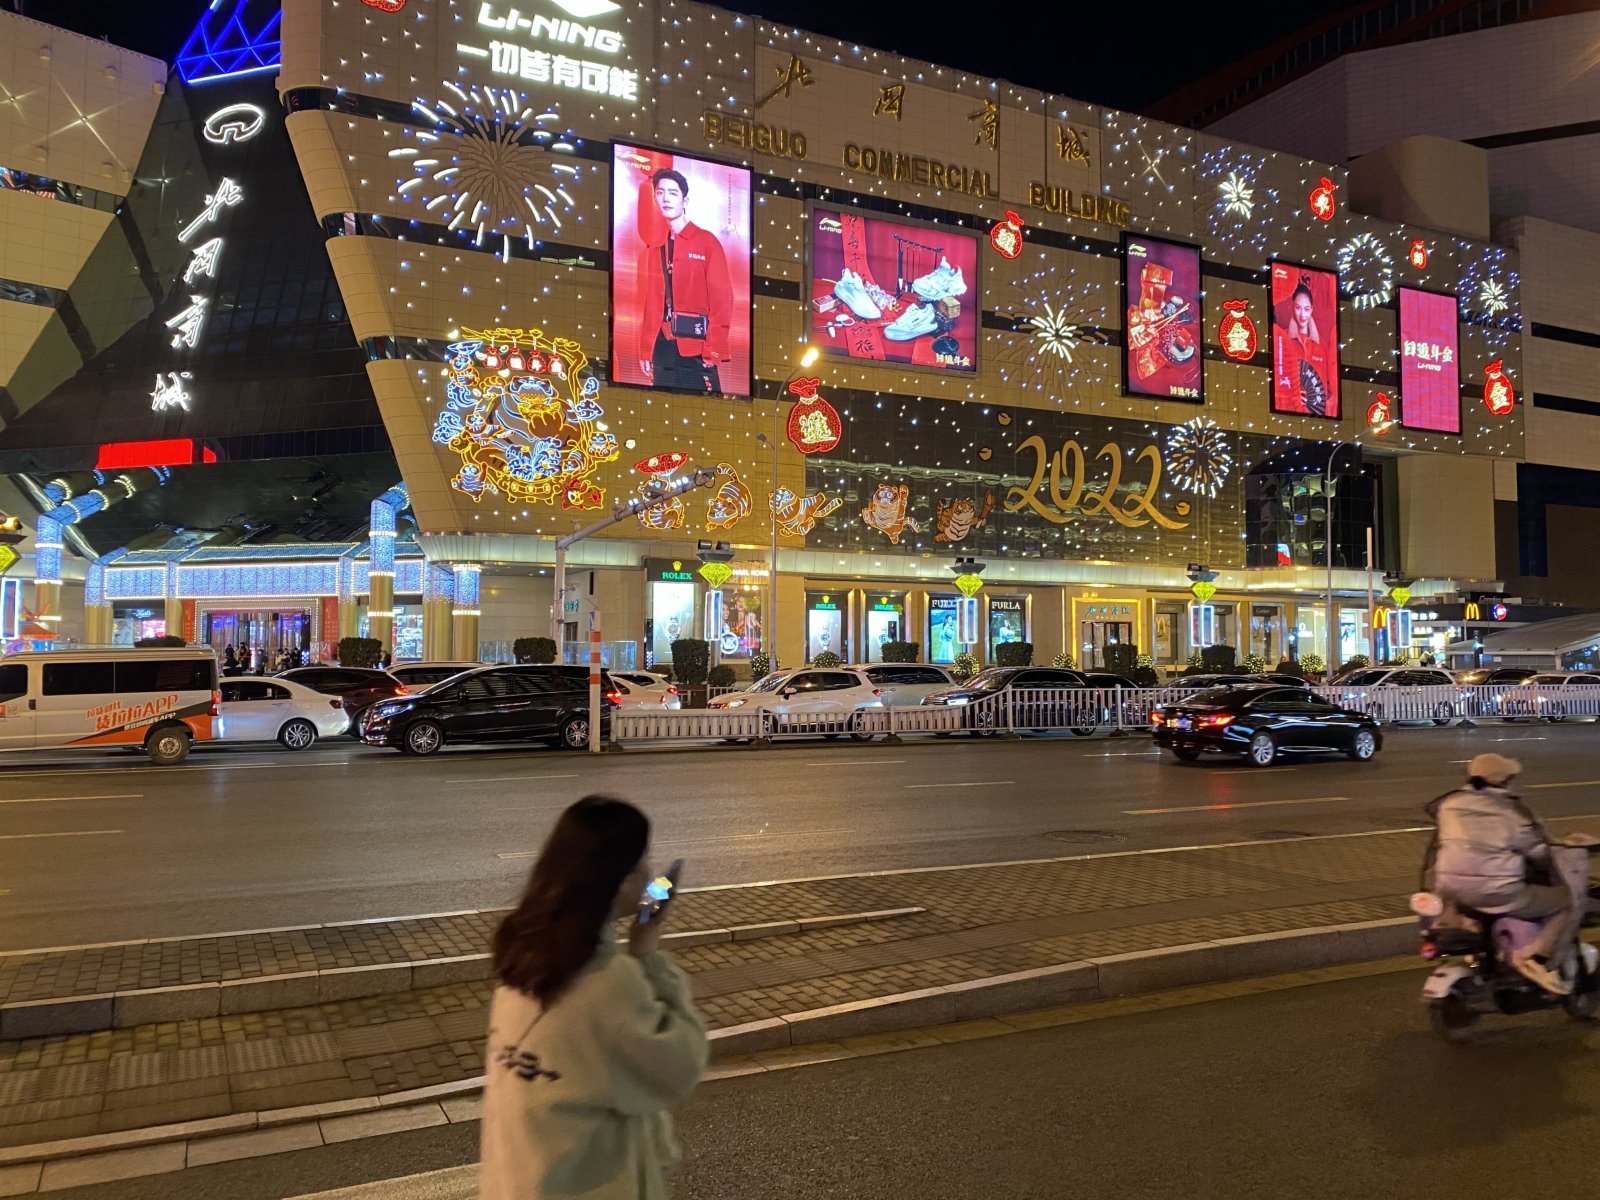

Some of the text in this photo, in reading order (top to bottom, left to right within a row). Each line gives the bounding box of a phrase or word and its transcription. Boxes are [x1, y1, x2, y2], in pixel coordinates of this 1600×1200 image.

[477, 2, 624, 53] LI-NING
[456, 40, 639, 101] 一切皆有可能
[703, 111, 1131, 227] BEIGUO COMMERCIAL BUILDING
[1004, 435, 1189, 530] 2022
[662, 572, 692, 580] ROLEX
[991, 601, 1021, 610] FURLA
